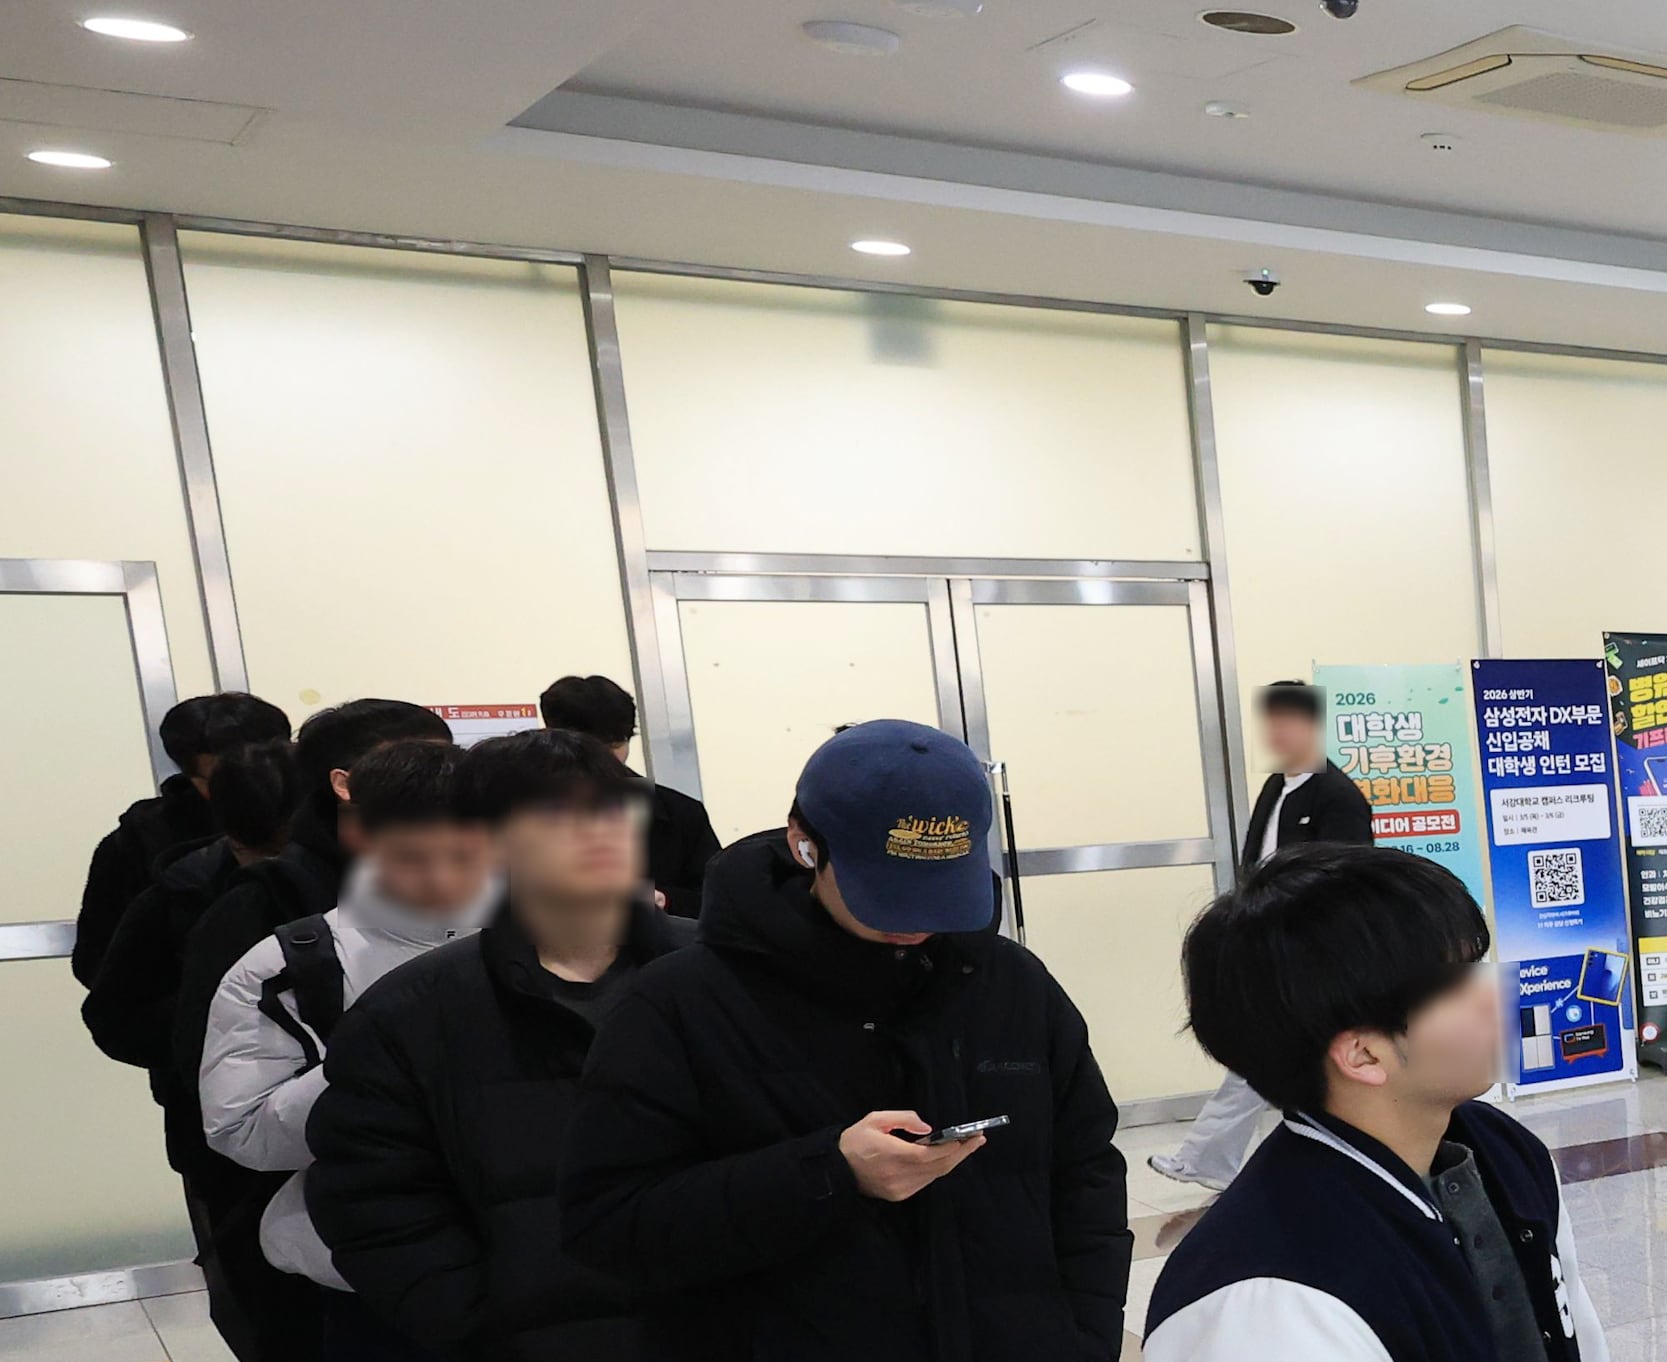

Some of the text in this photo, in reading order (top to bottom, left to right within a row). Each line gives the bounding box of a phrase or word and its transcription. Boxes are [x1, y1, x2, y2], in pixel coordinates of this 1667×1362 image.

[1336, 693, 1376, 706] 2026
[1483, 689, 1534, 700] 2026 상반기
[1484, 705, 1603, 727] 삼성전자 DX부문
[1337, 712, 1423, 743] 대학생
[1486, 731, 1550, 752] 신입공채
[1339, 743, 1453, 775] 기후환경
[1488, 753, 1606, 777] 대학생 인턴 모집
[1502, 793, 1595, 808] 서강대학교 캠퍼스 리크루팅
[1412, 814, 1456, 831] 공모전
[1426, 842, 1460, 853] 08.28
[1520, 965, 1548, 978] evice
